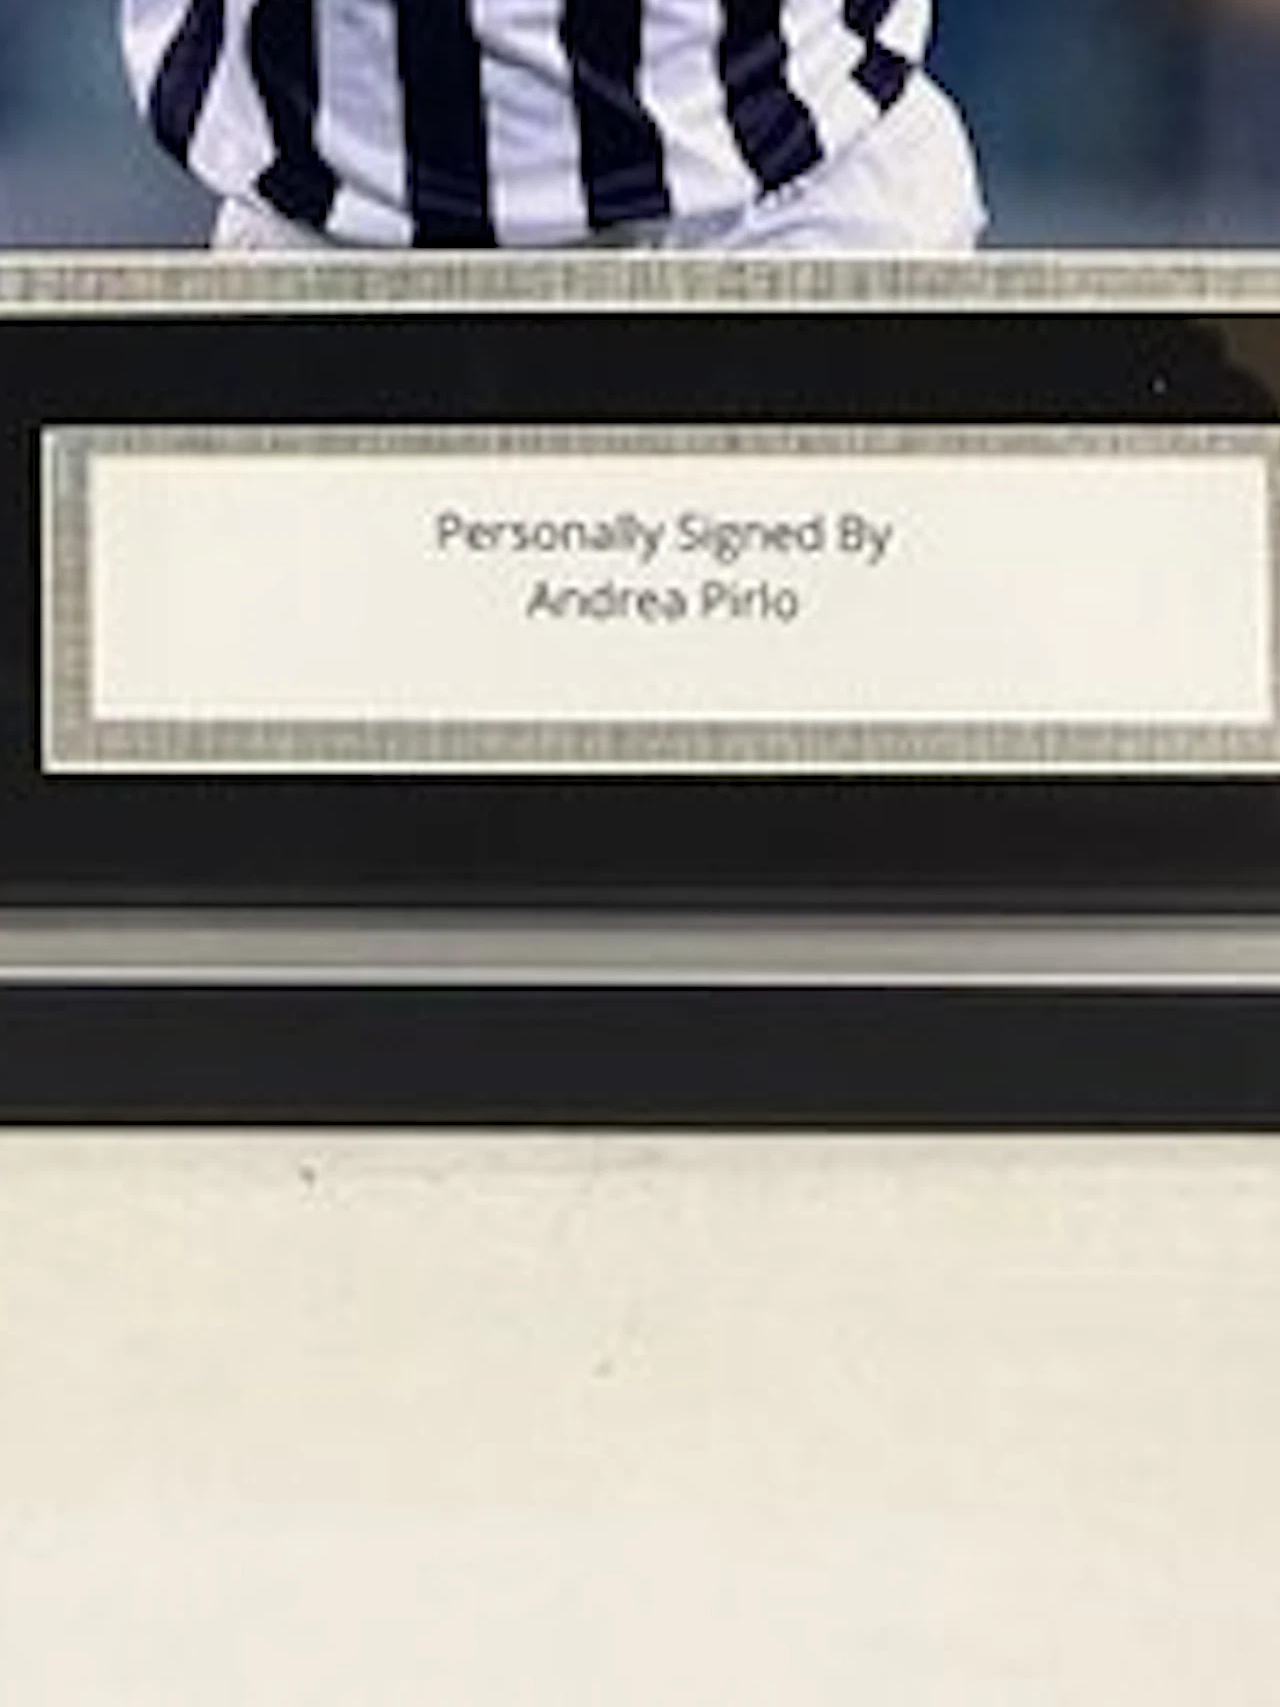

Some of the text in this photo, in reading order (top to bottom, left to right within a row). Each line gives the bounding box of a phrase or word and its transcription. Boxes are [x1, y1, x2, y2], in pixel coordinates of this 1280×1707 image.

[436, 512, 893, 566] Personally Signed By
[525, 581, 799, 621] Andrea Pirlo
